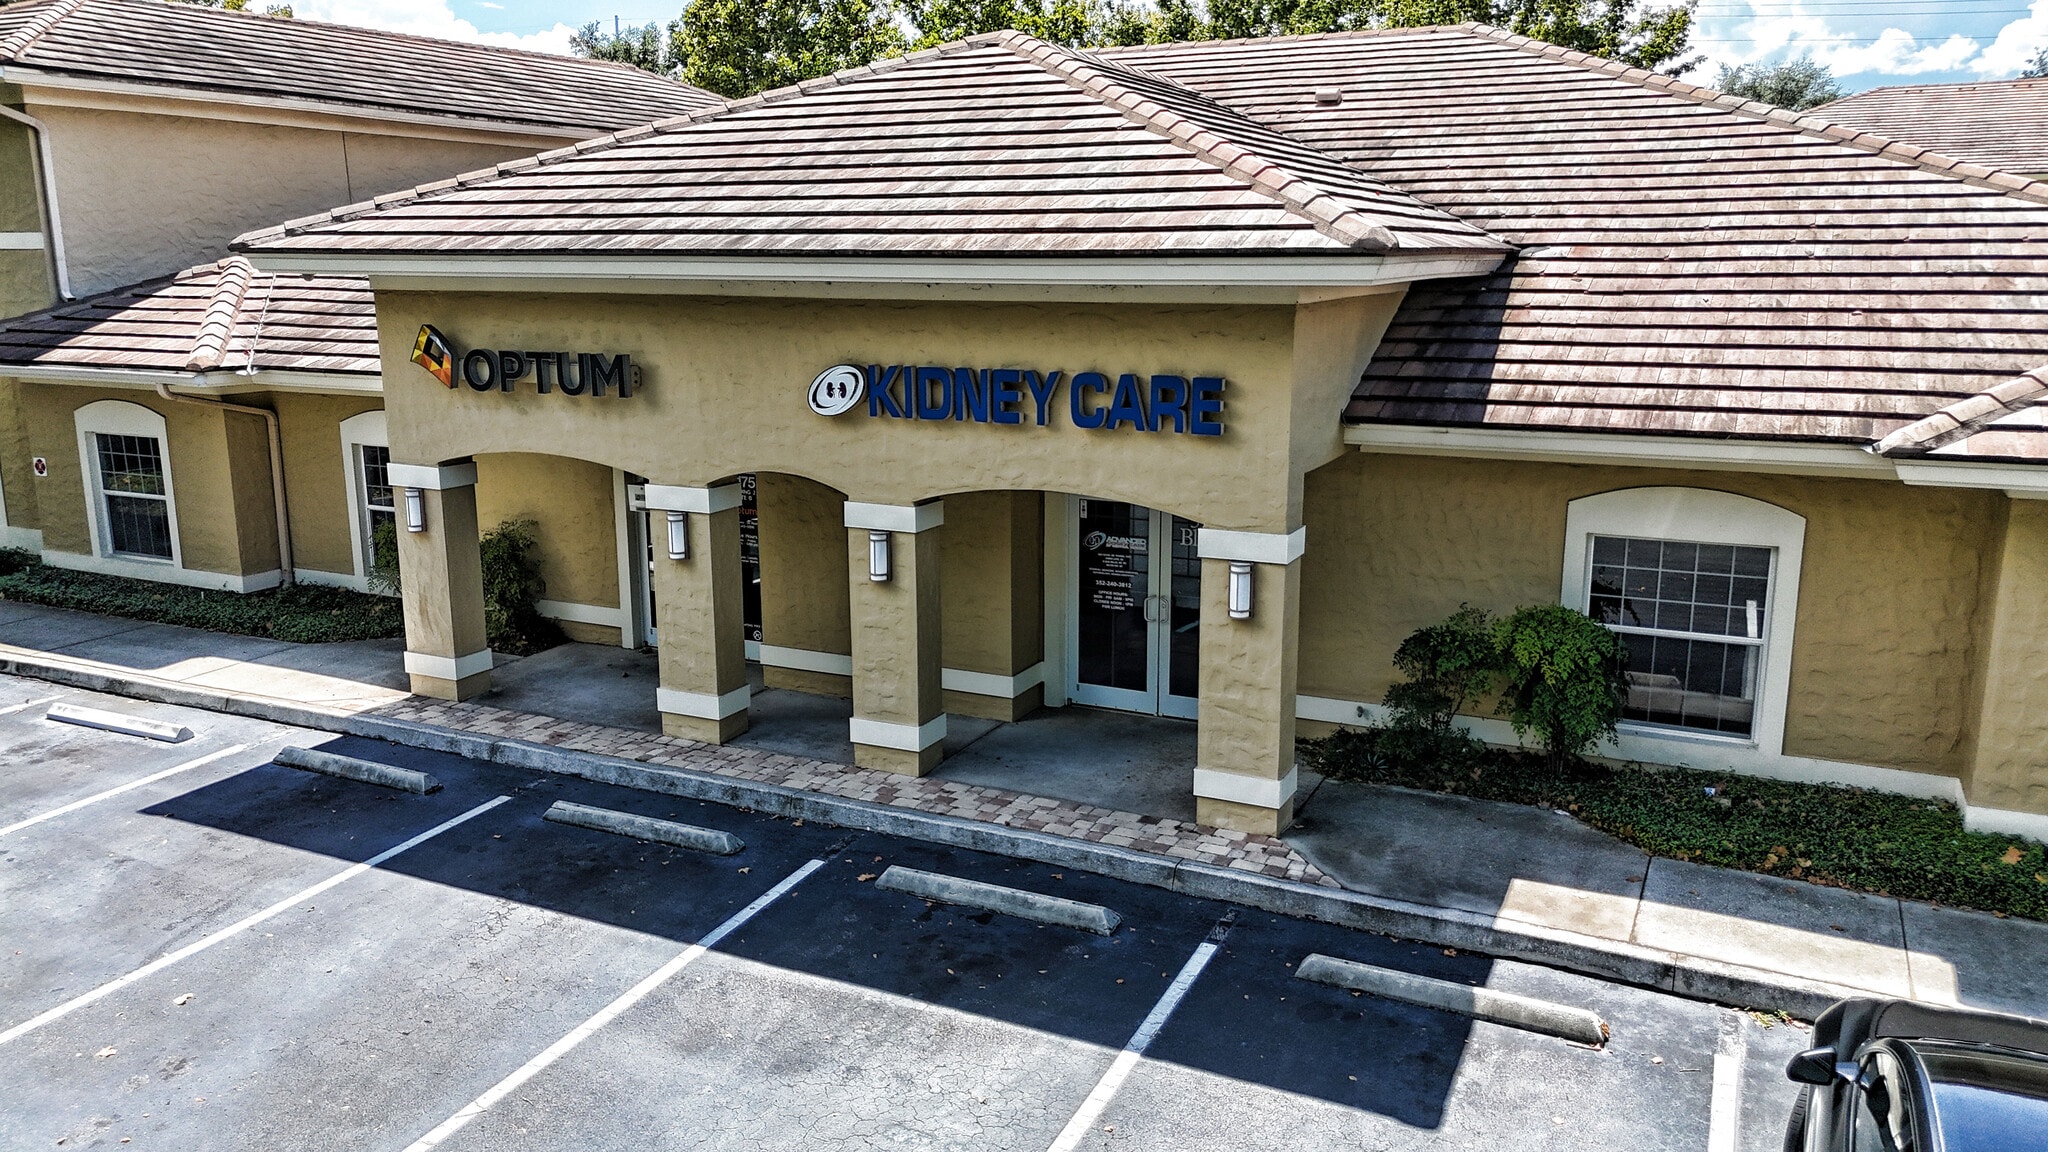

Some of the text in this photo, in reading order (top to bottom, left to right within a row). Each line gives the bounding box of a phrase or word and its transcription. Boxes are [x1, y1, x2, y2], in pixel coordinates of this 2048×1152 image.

[463, 349, 633, 398] OPTUM
[867, 364, 1227, 436] KIDNEY CARE
